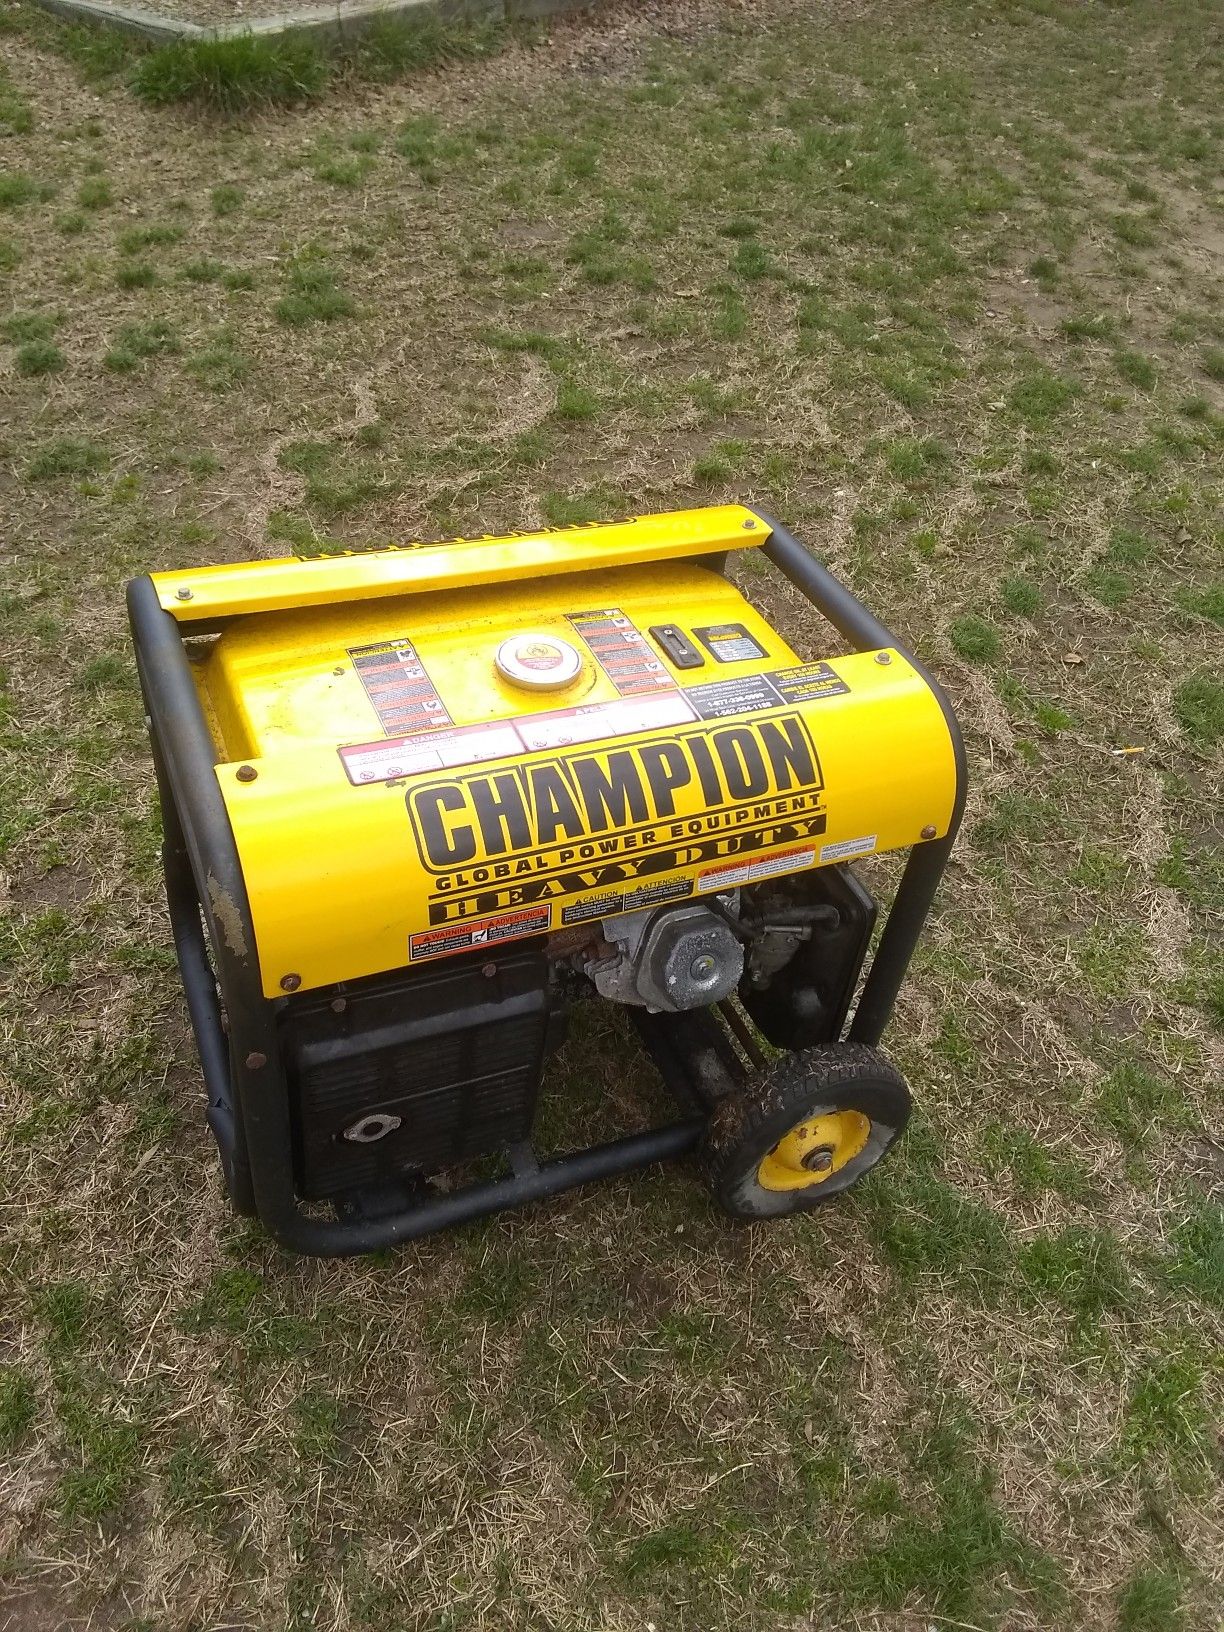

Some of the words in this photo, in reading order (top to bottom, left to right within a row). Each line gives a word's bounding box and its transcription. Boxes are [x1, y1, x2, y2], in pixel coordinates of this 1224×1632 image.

[413, 732, 455, 744] DANGER
[414, 717, 817, 866] CHAMPION
[435, 859, 548, 891] GLOBAL
[559, 829, 657, 863] POWER
[671, 793, 821, 838] EQUIPMENT
[445, 859, 644, 920] HEAVY
[674, 819, 817, 867] DUTY
[711, 861, 746, 874] WARNING
[583, 890, 619, 903] CAUTION
[495, 910, 545, 926] ADVERTENCIA
[432, 925, 472, 940] WARNING
